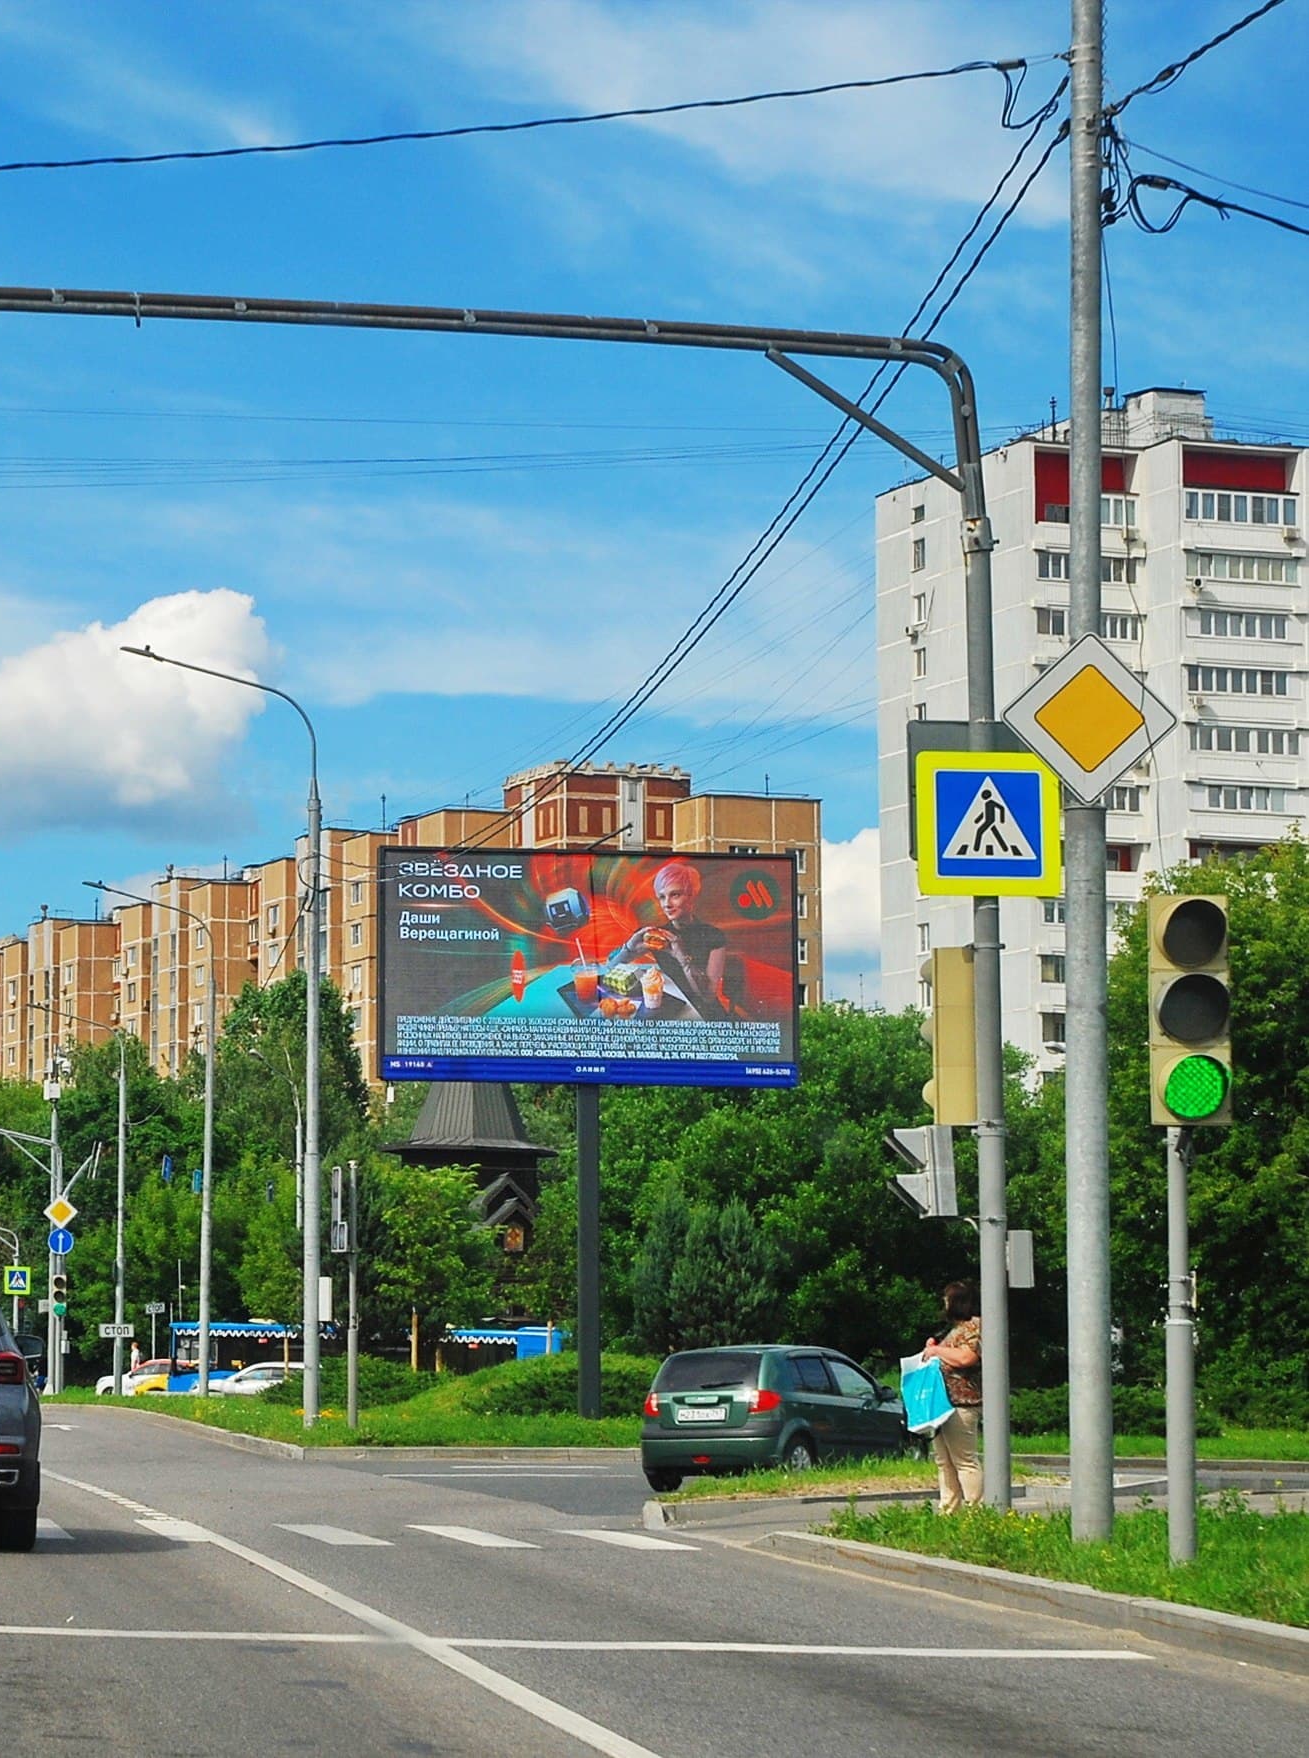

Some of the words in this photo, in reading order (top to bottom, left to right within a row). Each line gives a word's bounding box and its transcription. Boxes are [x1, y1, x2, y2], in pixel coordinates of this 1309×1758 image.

[398, 859, 523, 879] ЗВЁЗДНОЕ
[398, 883, 481, 899] КОМБО
[399, 911, 441, 925] Даши
[399, 926, 500, 941] Верещагиной
[104, 1326, 130, 1336] СТОП
